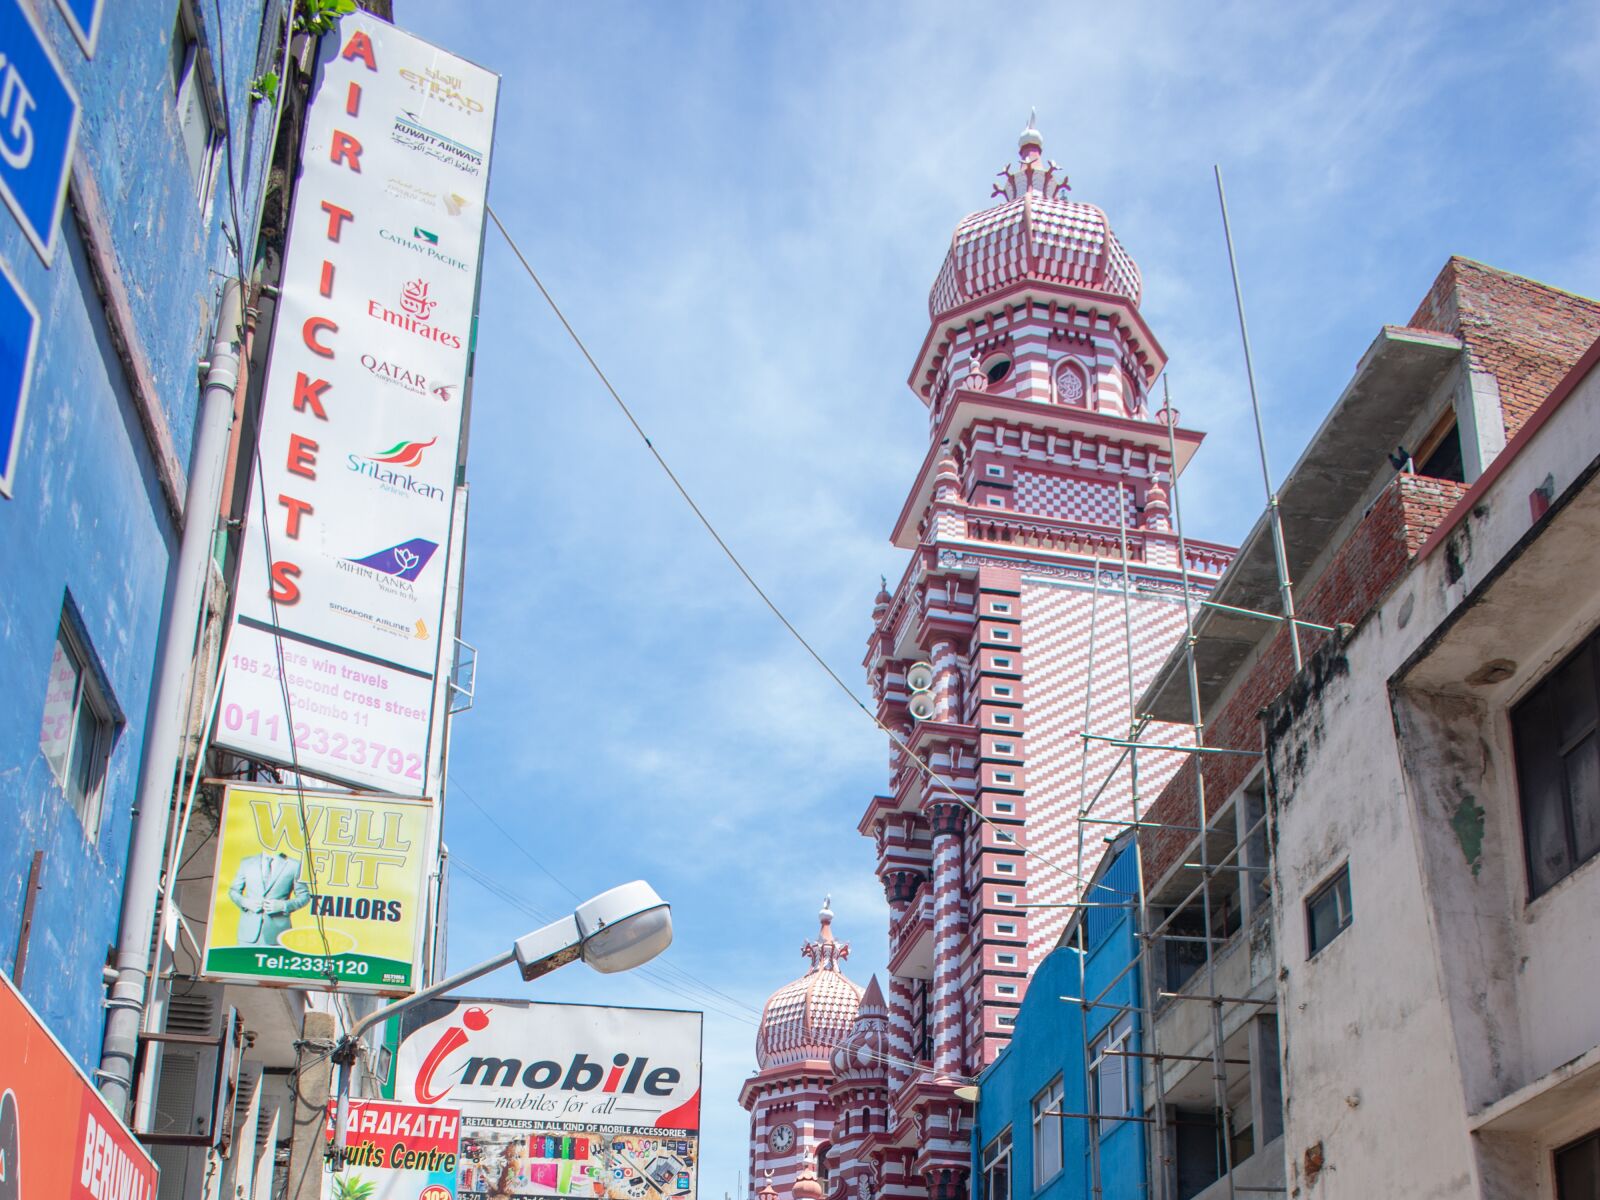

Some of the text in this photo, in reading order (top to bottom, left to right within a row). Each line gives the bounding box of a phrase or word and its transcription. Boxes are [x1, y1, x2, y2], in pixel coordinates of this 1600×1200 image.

[398, 66, 484, 112] ETIHAD
[394, 122, 482, 166] KUWAIT AIRWAYS
[379, 228, 469, 272] CATHAY PACIFIC
[267, 30, 377, 609] AIR TICKETS
[368, 299, 461, 349] Emirates
[360, 353, 426, 390] QATAR
[335, 560, 415, 594] MIHIN LANKA
[232, 654, 258, 674] 195
[288, 673, 340, 697] second
[343, 689, 381, 709] cross
[385, 698, 427, 723] street
[279, 645, 389, 690] are win travels
[287, 692, 349, 722] Colombo
[224, 703, 424, 781] 011 2323792
[250, 800, 412, 852] WELL
[296, 848, 407, 889] FIT
[310, 894, 402, 922] TAILORS
[466, 1118, 687, 1137] RETAIL DEALERS IN ALL KIND OF MOBILE ACCESSORIES
[494, 1093, 618, 1119] mobiles for all
[390, 1143, 457, 1173] Centre
